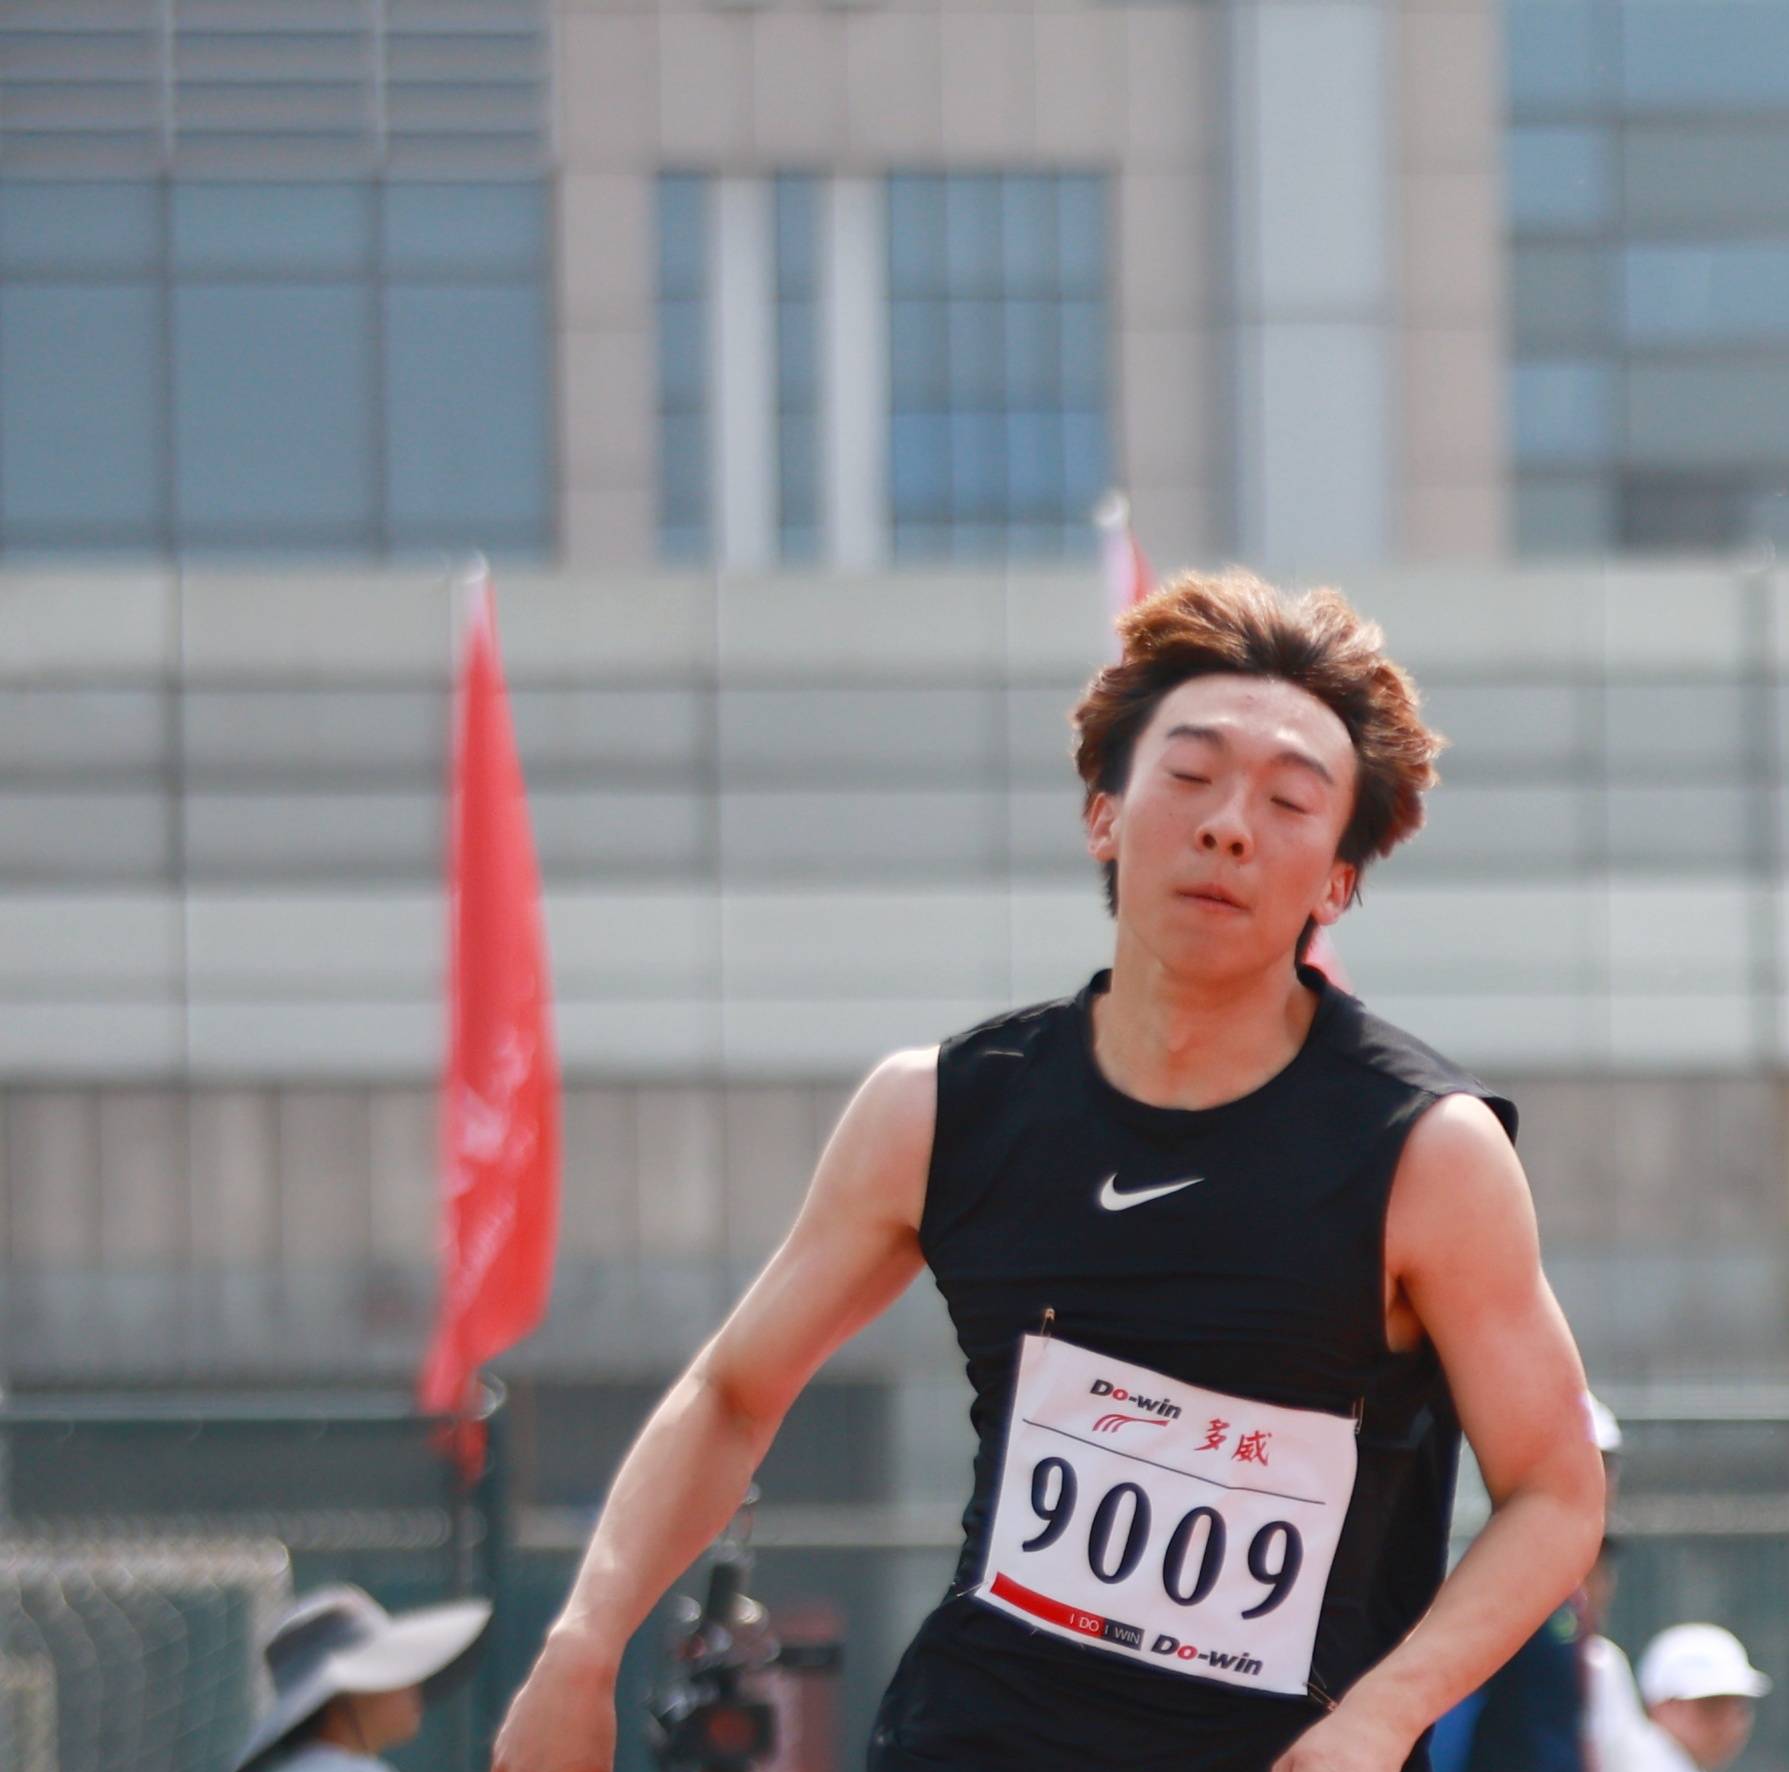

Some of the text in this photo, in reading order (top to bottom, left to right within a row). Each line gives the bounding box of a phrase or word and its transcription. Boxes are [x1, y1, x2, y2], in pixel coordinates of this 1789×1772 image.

[1089, 1378, 1183, 1420] Do-win
[1194, 1418, 1273, 1467] 多威
[1020, 1455, 1306, 1621] 9009
[1078, 1616, 1099, 1632] DO
[1114, 1626, 1142, 1645] WIN
[1150, 1633, 1264, 1676] Do-win
